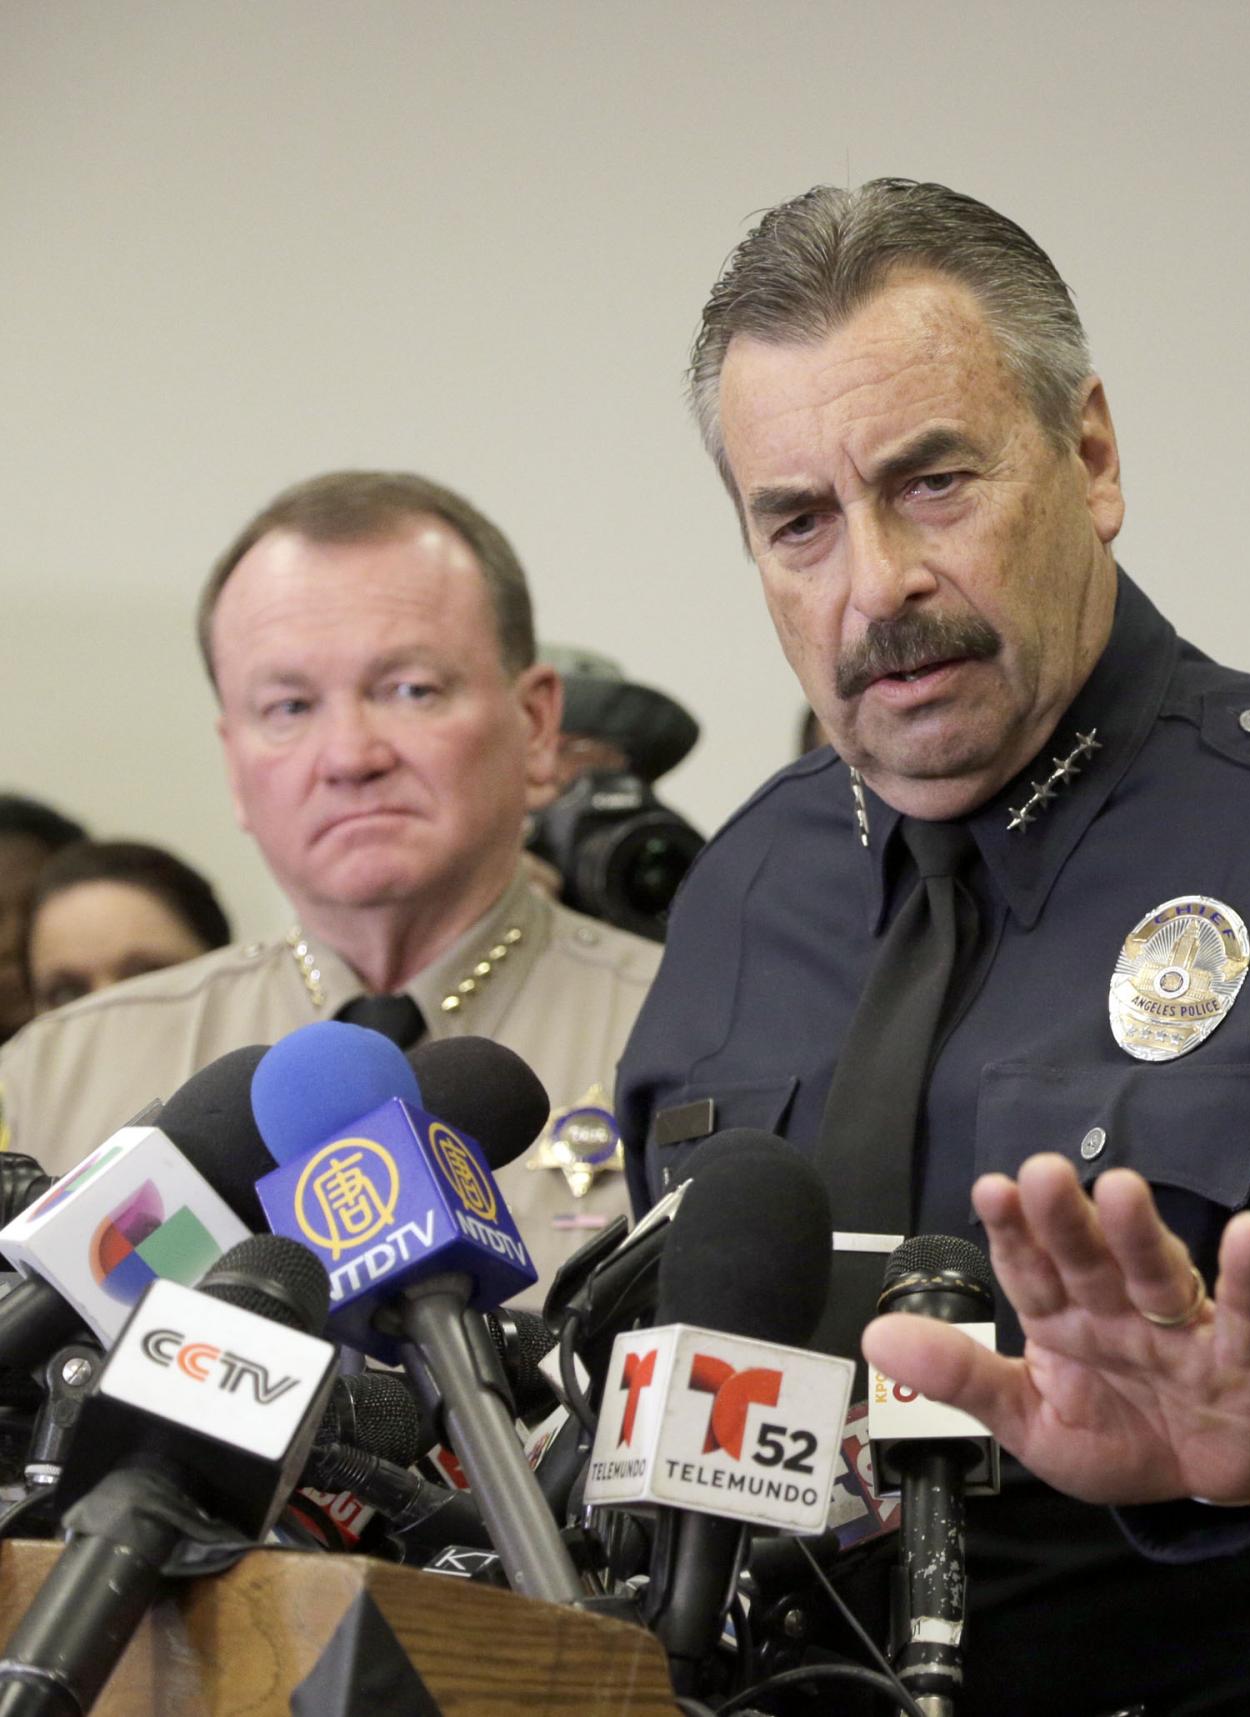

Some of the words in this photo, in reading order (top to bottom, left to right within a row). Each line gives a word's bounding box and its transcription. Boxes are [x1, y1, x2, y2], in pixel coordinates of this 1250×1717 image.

[1154, 904, 1236, 942] CHIEF
[1131, 996, 1176, 1017] ANGELES
[1180, 1000, 1221, 1017] POLICE
[455, 1209, 527, 1267] NTDTV
[140, 1328, 301, 1405] CCTV
[591, 1458, 647, 1482] TELEMUNDO
[751, 1422, 818, 1476] 52
[664, 1459, 818, 1507] TELEMUNDO
